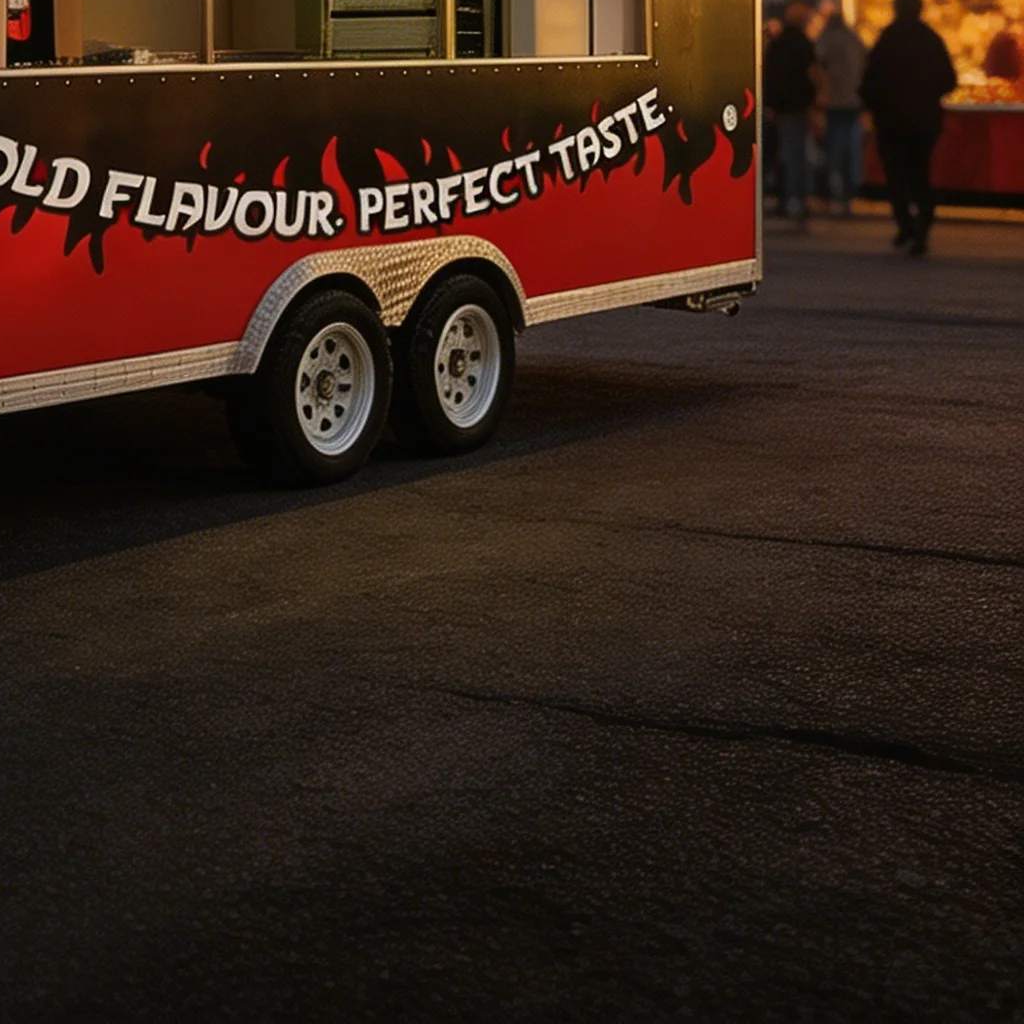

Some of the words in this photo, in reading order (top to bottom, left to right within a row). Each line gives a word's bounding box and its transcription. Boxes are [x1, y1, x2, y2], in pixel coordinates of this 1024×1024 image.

[99, 170, 344, 236] FLAVOUR.
[358, 150, 541, 232] PERFECT
[548, 86, 674, 181] TASTE.
